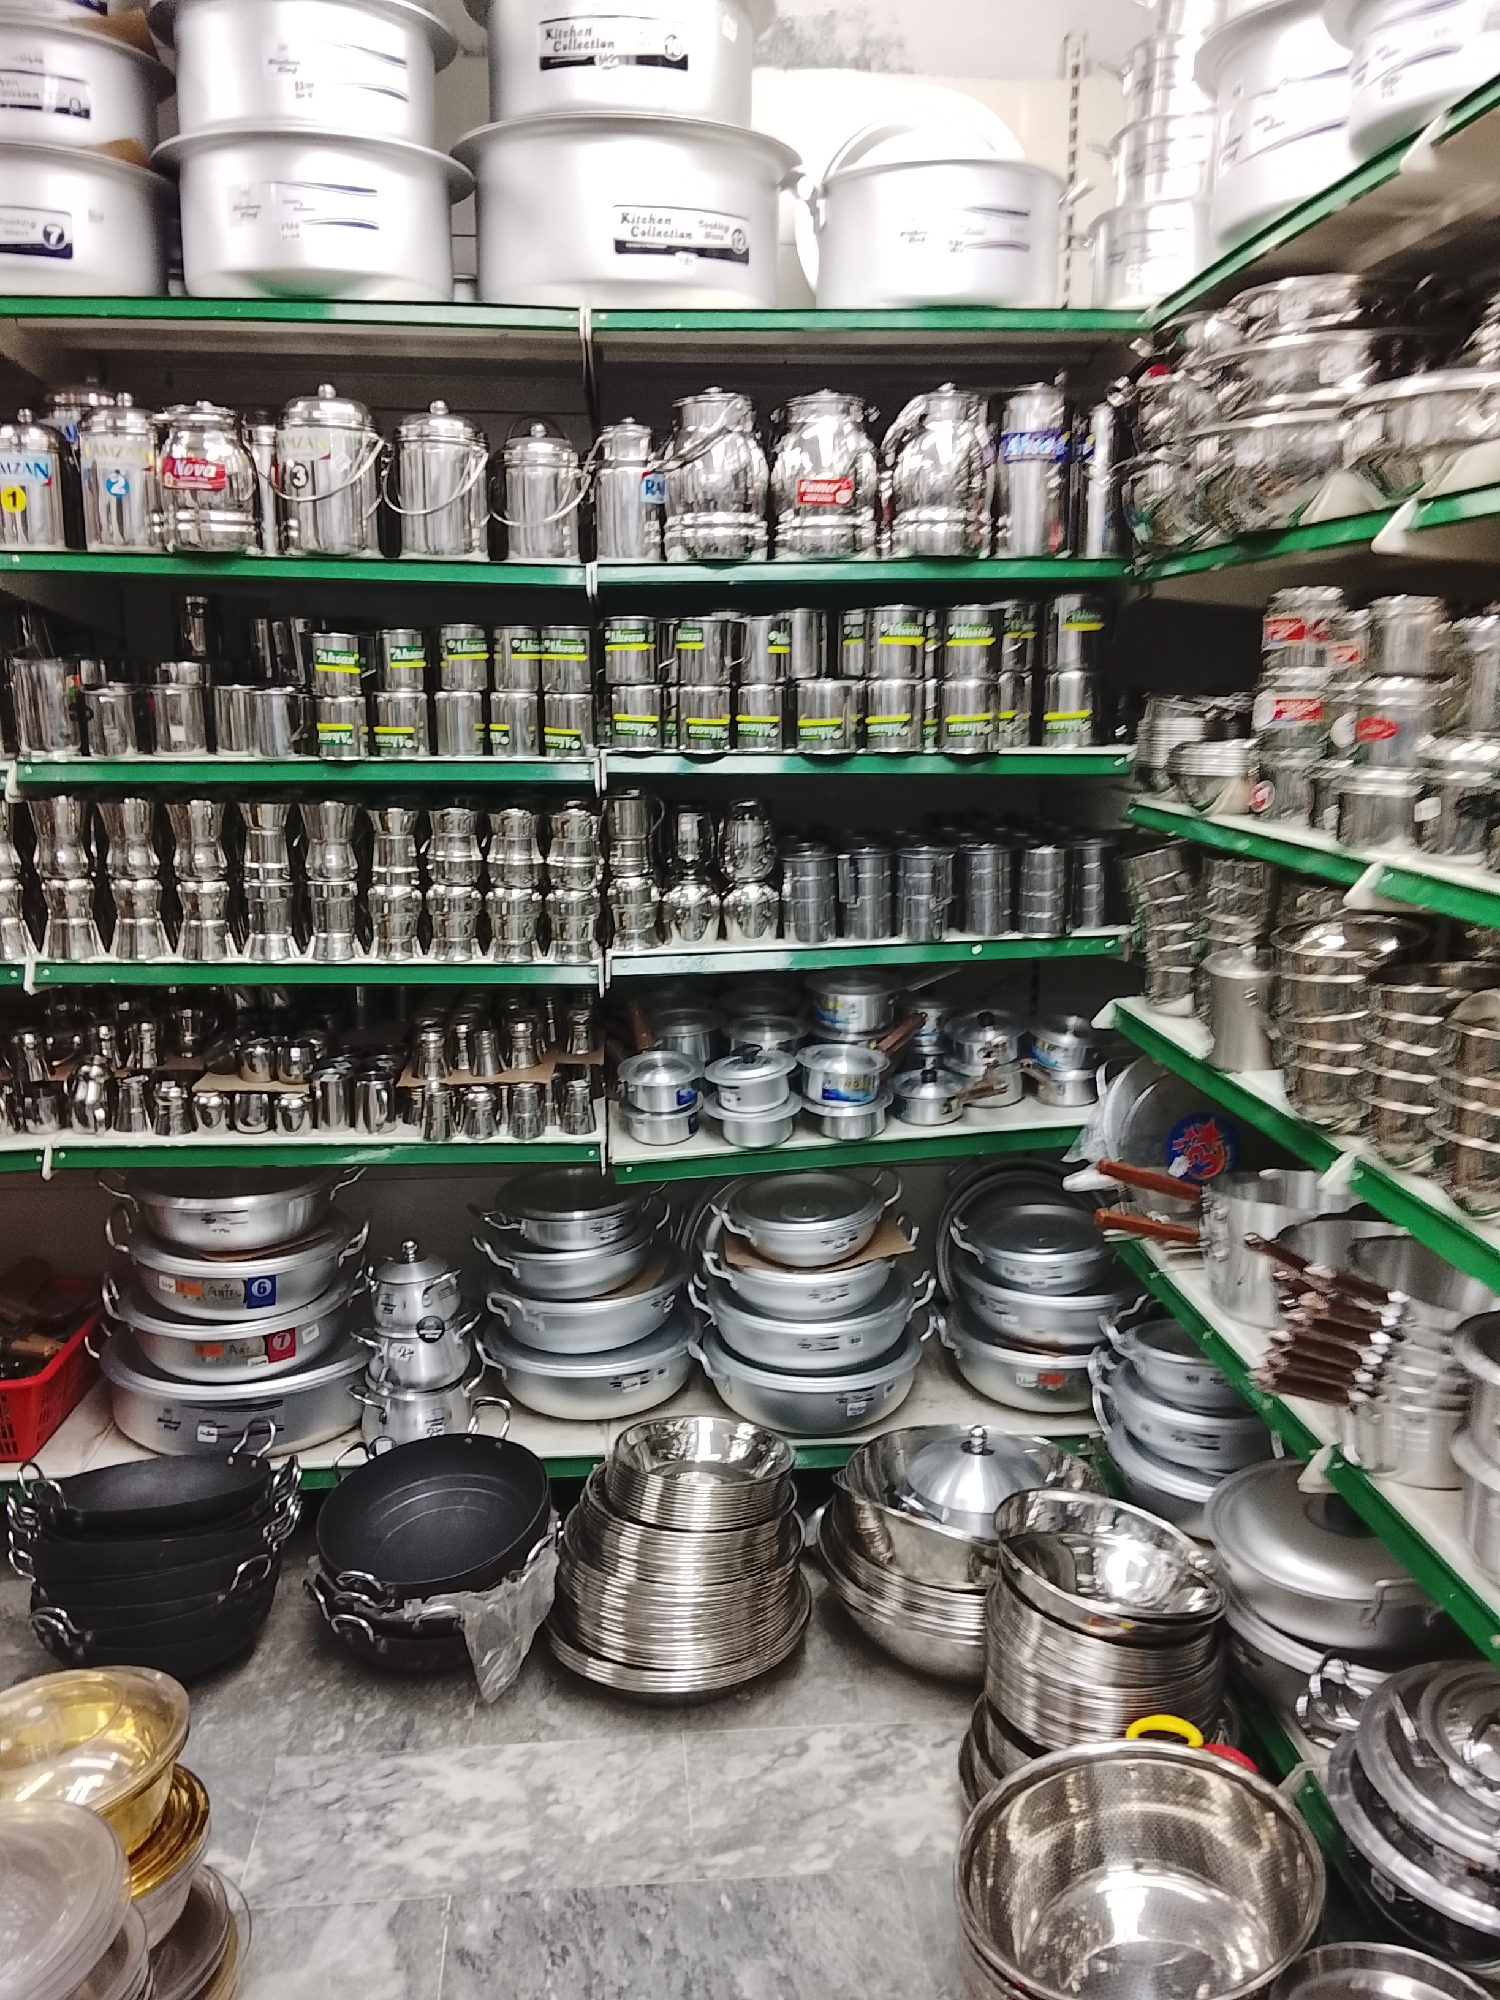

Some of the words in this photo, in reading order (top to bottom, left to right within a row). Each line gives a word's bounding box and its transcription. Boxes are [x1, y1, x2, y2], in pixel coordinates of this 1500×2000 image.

[545, 25, 592, 40] Kitchen
[553, 39, 614, 52] Collection
[620, 212, 672, 225] Kitchen
[46, 226, 62, 245] 7
[630, 226, 693, 239] Collection
[173, 459, 217, 477] Nova
[292, 465, 307, 487] 3
[110, 472, 127, 495] 2
[257, 1281, 267, 1294] 6
[278, 1334, 288, 1348] 7
